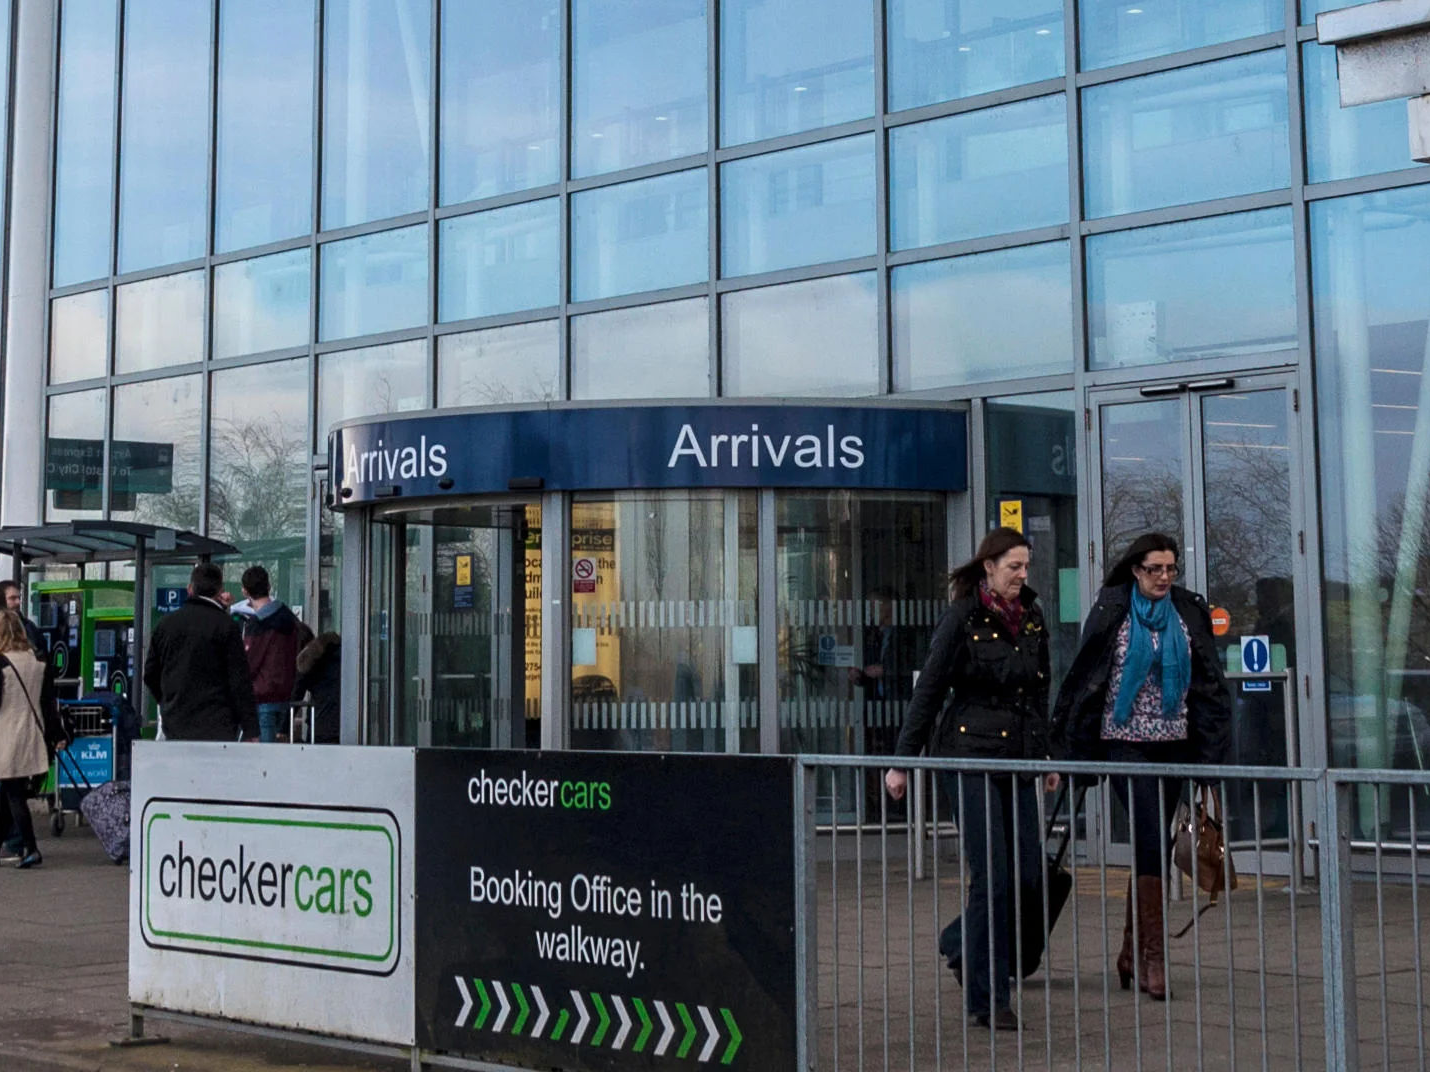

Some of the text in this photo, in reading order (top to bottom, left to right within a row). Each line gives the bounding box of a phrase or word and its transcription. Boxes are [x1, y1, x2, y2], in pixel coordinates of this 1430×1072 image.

[347, 435, 448, 486] Arrivals
[667, 423, 865, 469] Arrivals
[168, 590, 177, 604] P
[81, 750, 108, 760] KLM
[468, 768, 612, 810] checkercars
[159, 839, 373, 917] checkercars
[470, 865, 723, 923] Booking Office in the
[535, 924, 645, 979] walkway.
